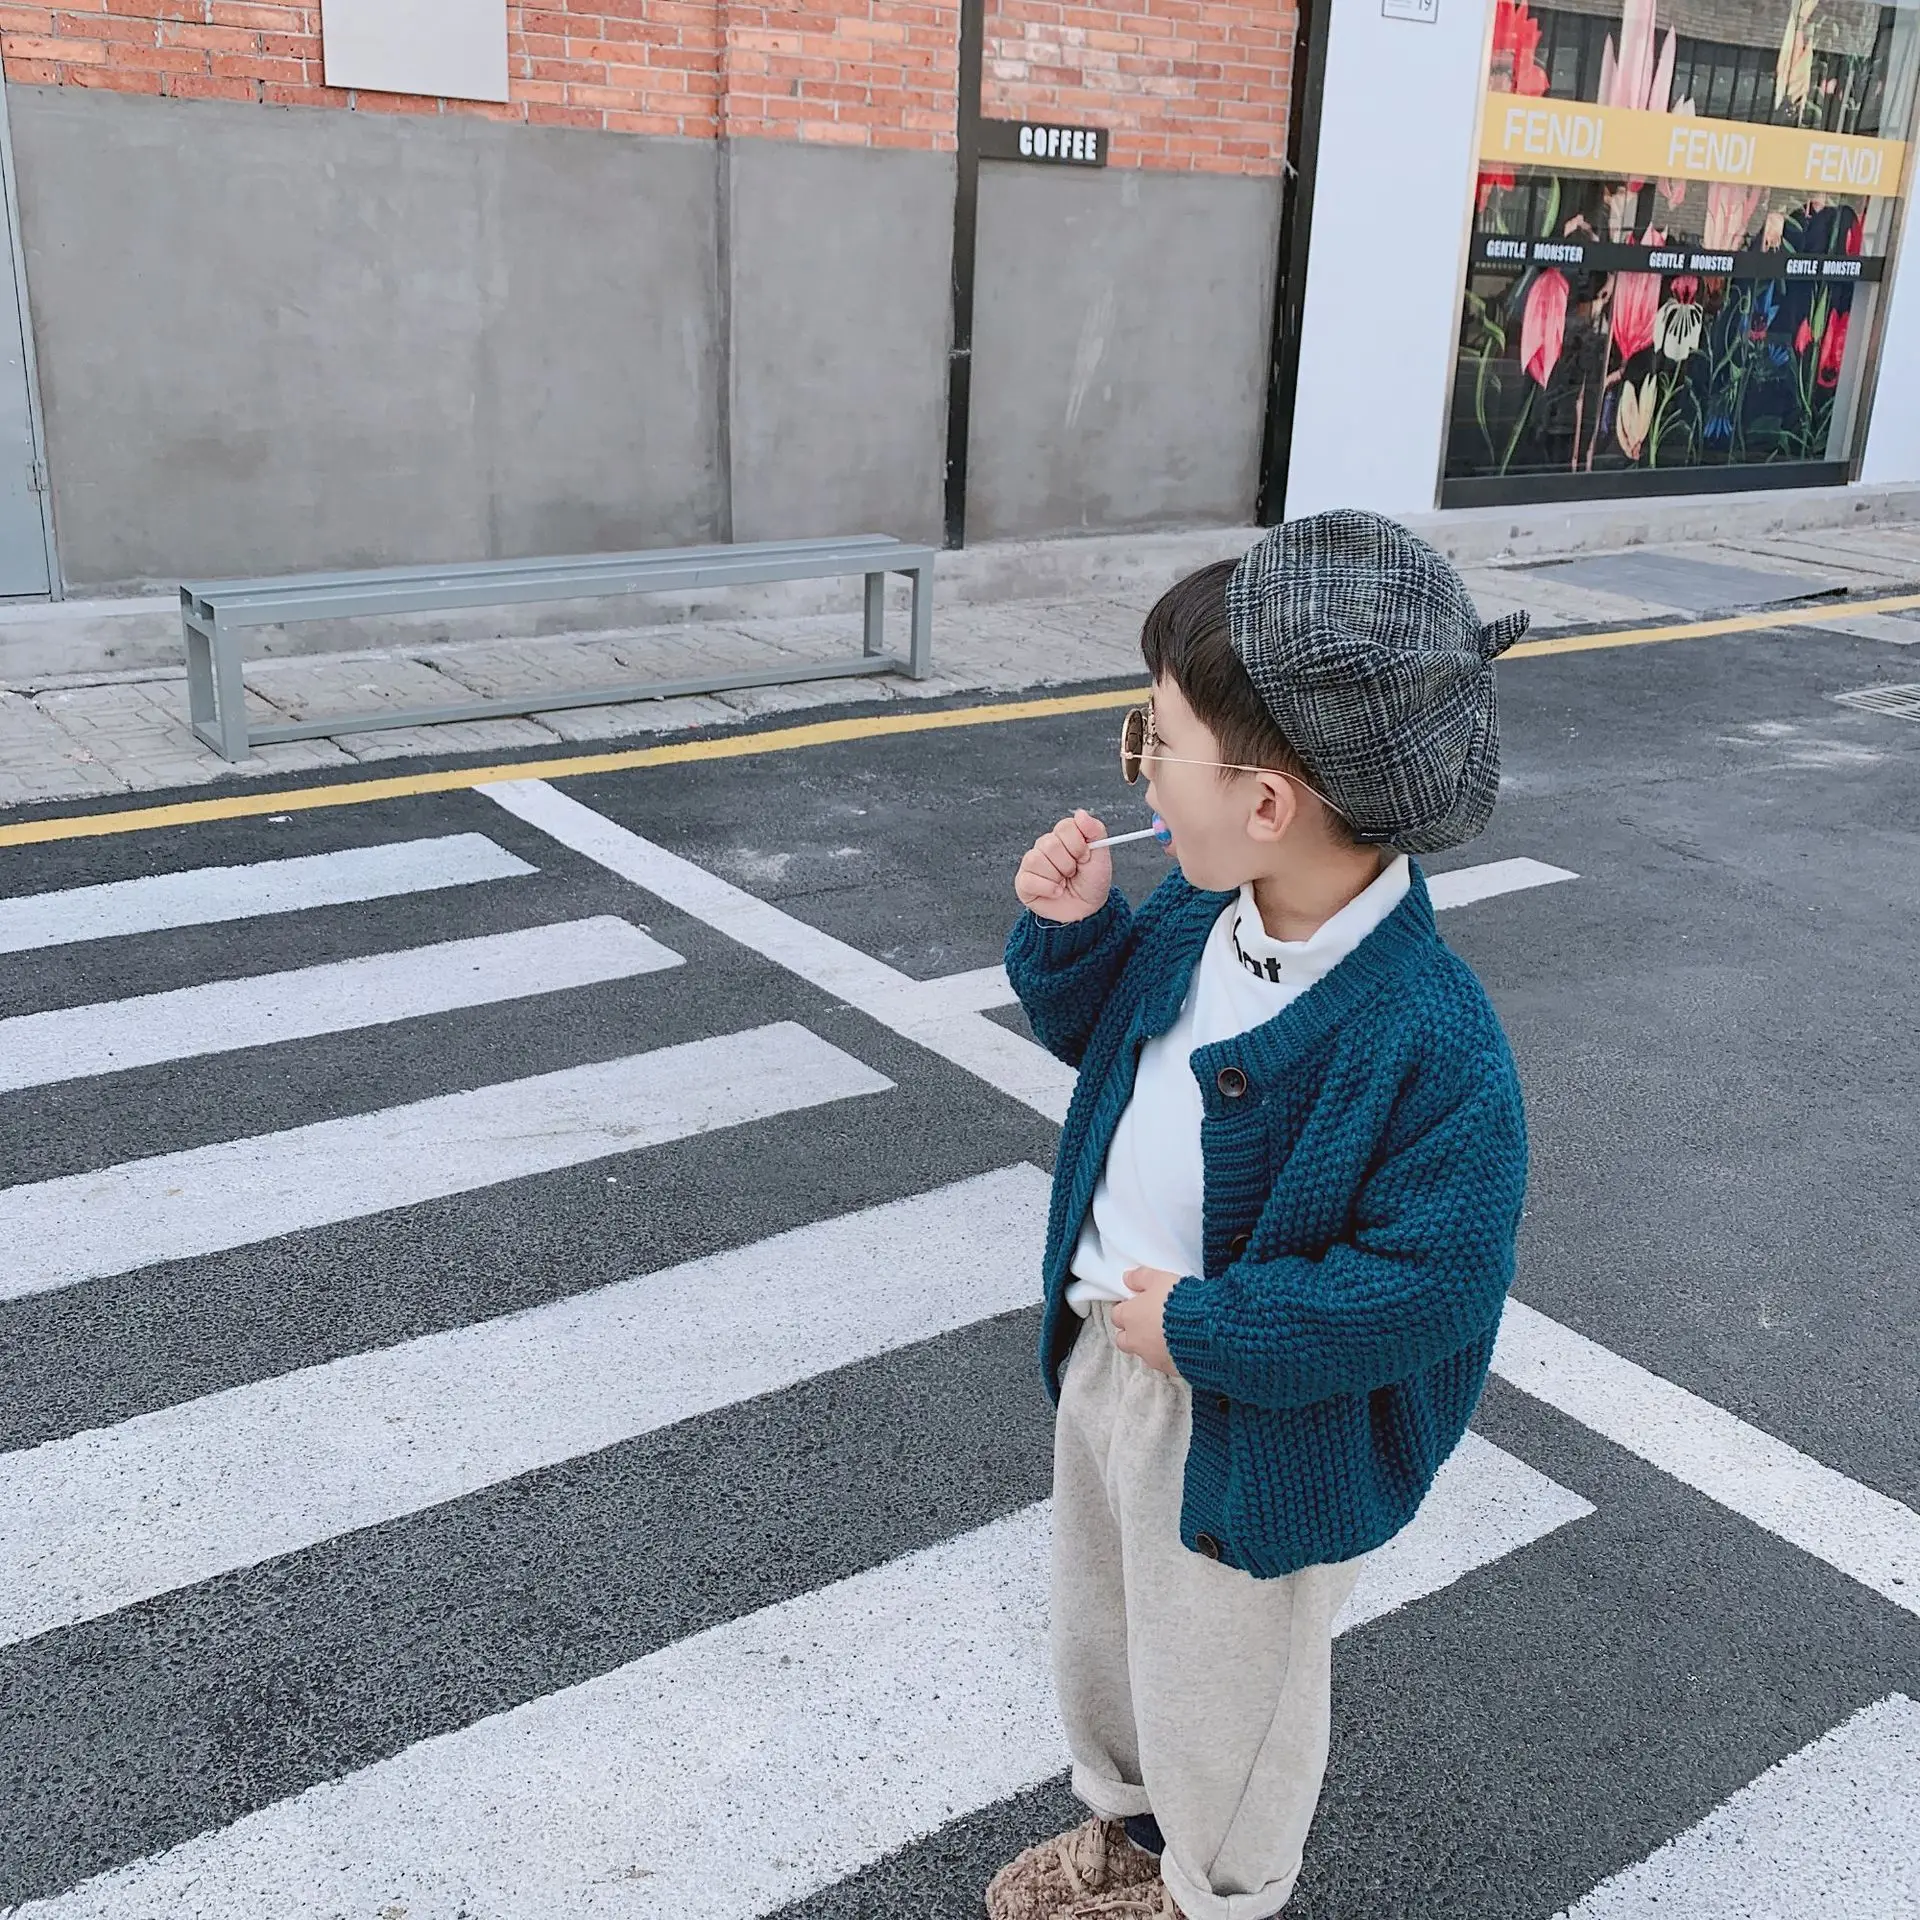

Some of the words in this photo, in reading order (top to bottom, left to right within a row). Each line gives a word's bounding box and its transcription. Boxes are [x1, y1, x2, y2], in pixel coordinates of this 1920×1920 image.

[1020, 126, 1097, 161] COFFEE
[1503, 108, 1604, 160] FENDI
[1667, 126, 1757, 177] FENDI
[1804, 142, 1884, 186] FENDI
[1486, 240, 1528, 259] GENTLE
[1533, 243, 1584, 263] MONSTER
[1649, 251, 1686, 269] GENTLE
[1690, 254, 1734, 272] MONSTER
[1786, 259, 1819, 275] GENTLE
[1822, 260, 1862, 276] MONSTER
